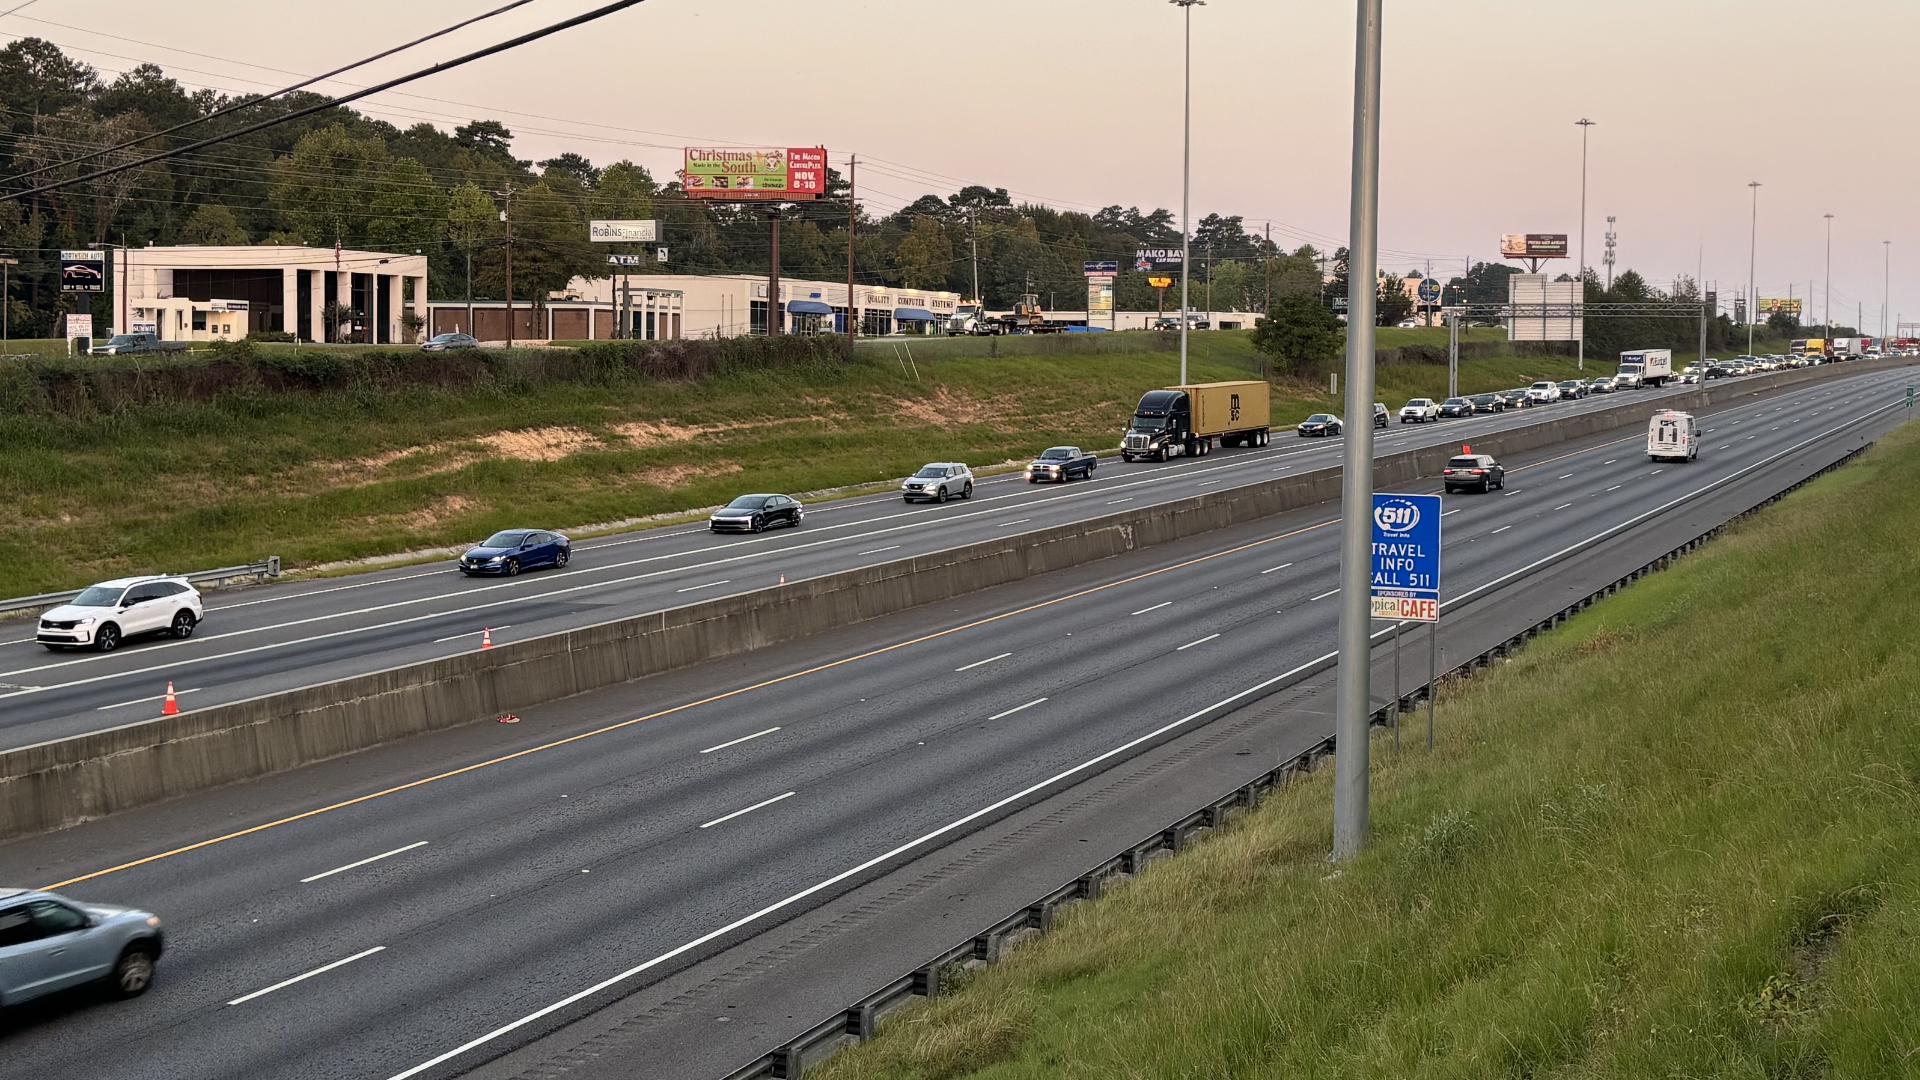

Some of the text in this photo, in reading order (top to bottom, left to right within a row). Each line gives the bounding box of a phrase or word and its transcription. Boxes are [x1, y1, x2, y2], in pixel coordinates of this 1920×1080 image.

[690, 149, 753, 161] Christmas
[721, 161, 757, 173] South
[794, 171, 816, 180] NOV.
[793, 180, 816, 189] 8-10
[622, 227, 654, 237] Financial
[608, 255, 639, 264] ATM
[1136, 249, 1166, 258] MAKO
[867, 294, 954, 309] QUALITY COMPUTER SYSTEMS
[1382, 507, 1411, 525] 511
[1372, 542, 1426, 558] TRAVEL
[1380, 558, 1414, 571] INFO
[1371, 571, 1430, 587] ALL 511
[1377, 590, 1409, 598] SPONSORED
[1400, 599, 1436, 619] CAFE
